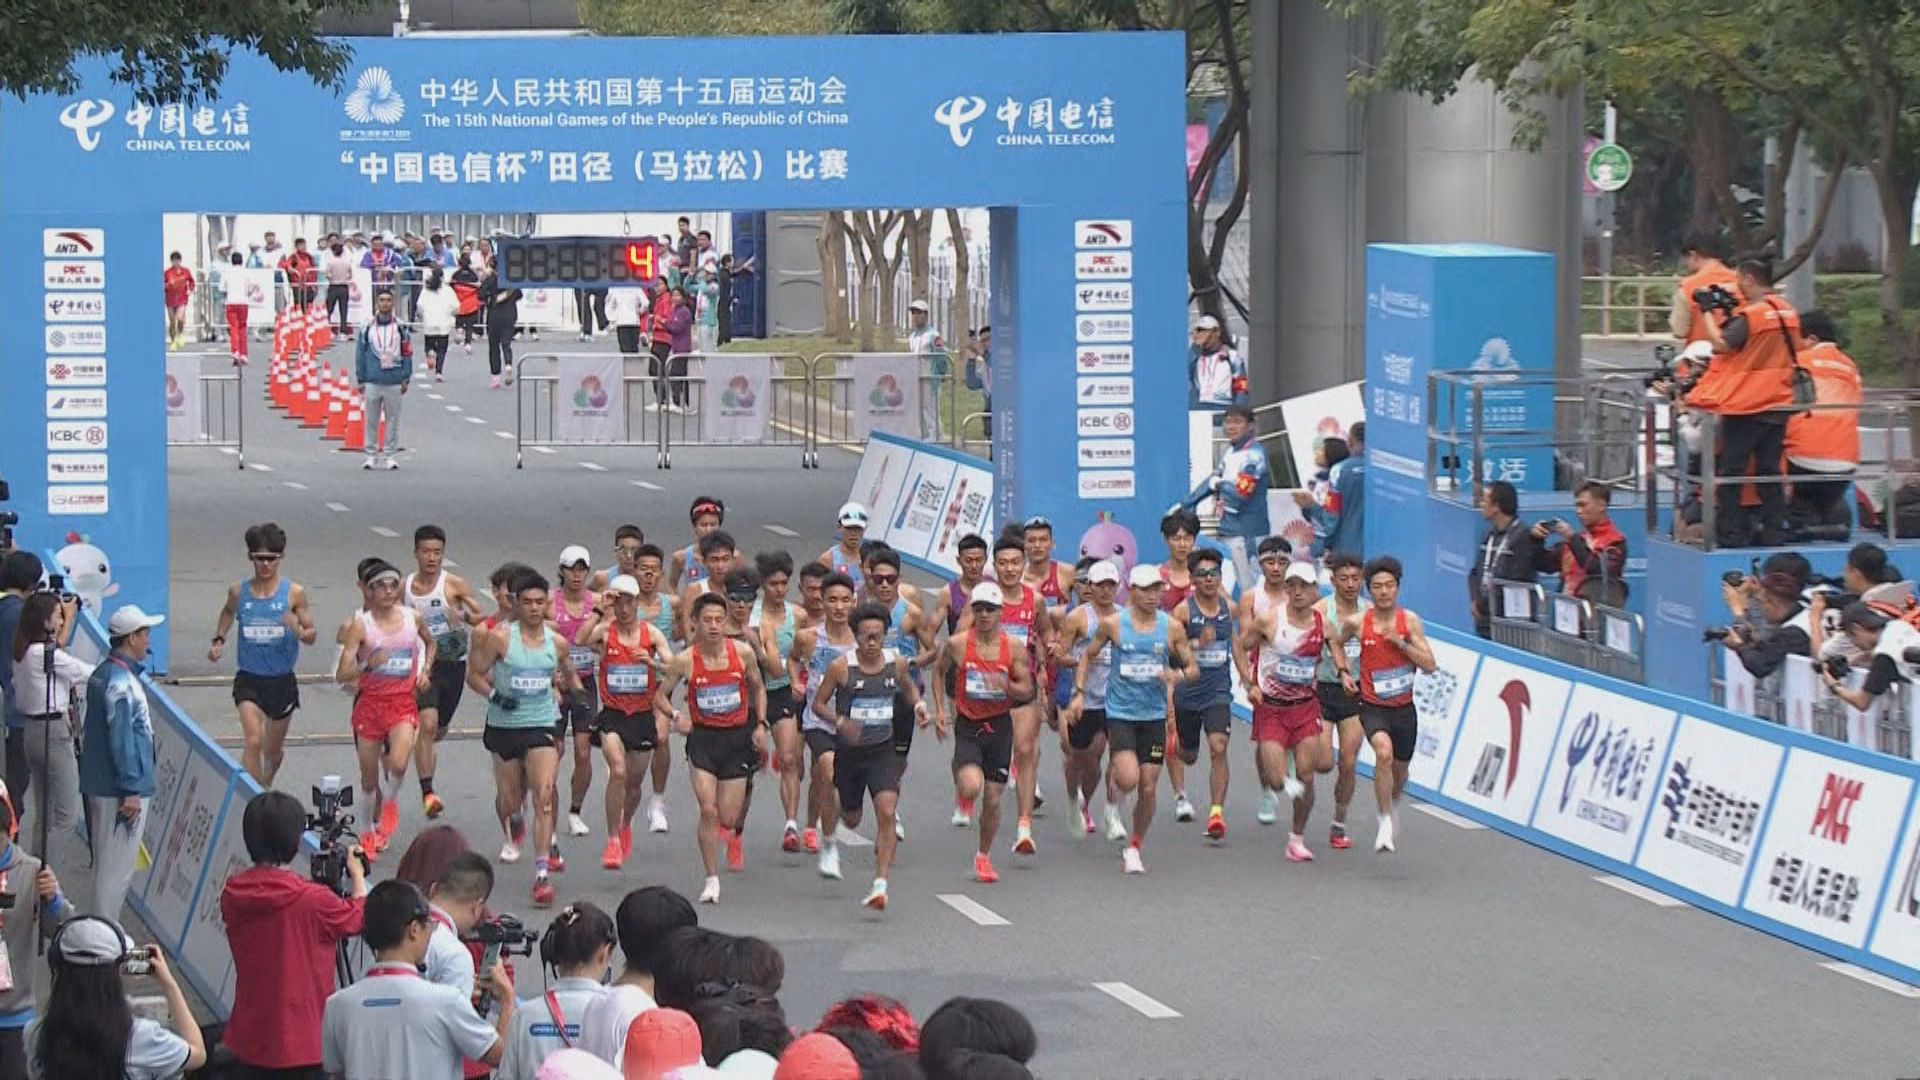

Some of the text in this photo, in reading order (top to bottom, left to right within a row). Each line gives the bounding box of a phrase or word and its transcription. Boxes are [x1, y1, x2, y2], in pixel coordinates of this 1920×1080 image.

[420, 76, 847, 107] 中华人民共和国第十五届运动会
[125, 100, 249, 138] 中国电信
[422, 110, 848, 127] The 15th National Games of the People's Republic of China
[996, 96, 1114, 133] 中国电信
[126, 140, 250, 151] CHINA TELECOM
[997, 133, 1115, 145] CHINA TELECOM
[1080, 416, 1110, 428] ICBC
[50, 430, 82, 441] ICBC
[1808, 771, 1865, 845] PICC
